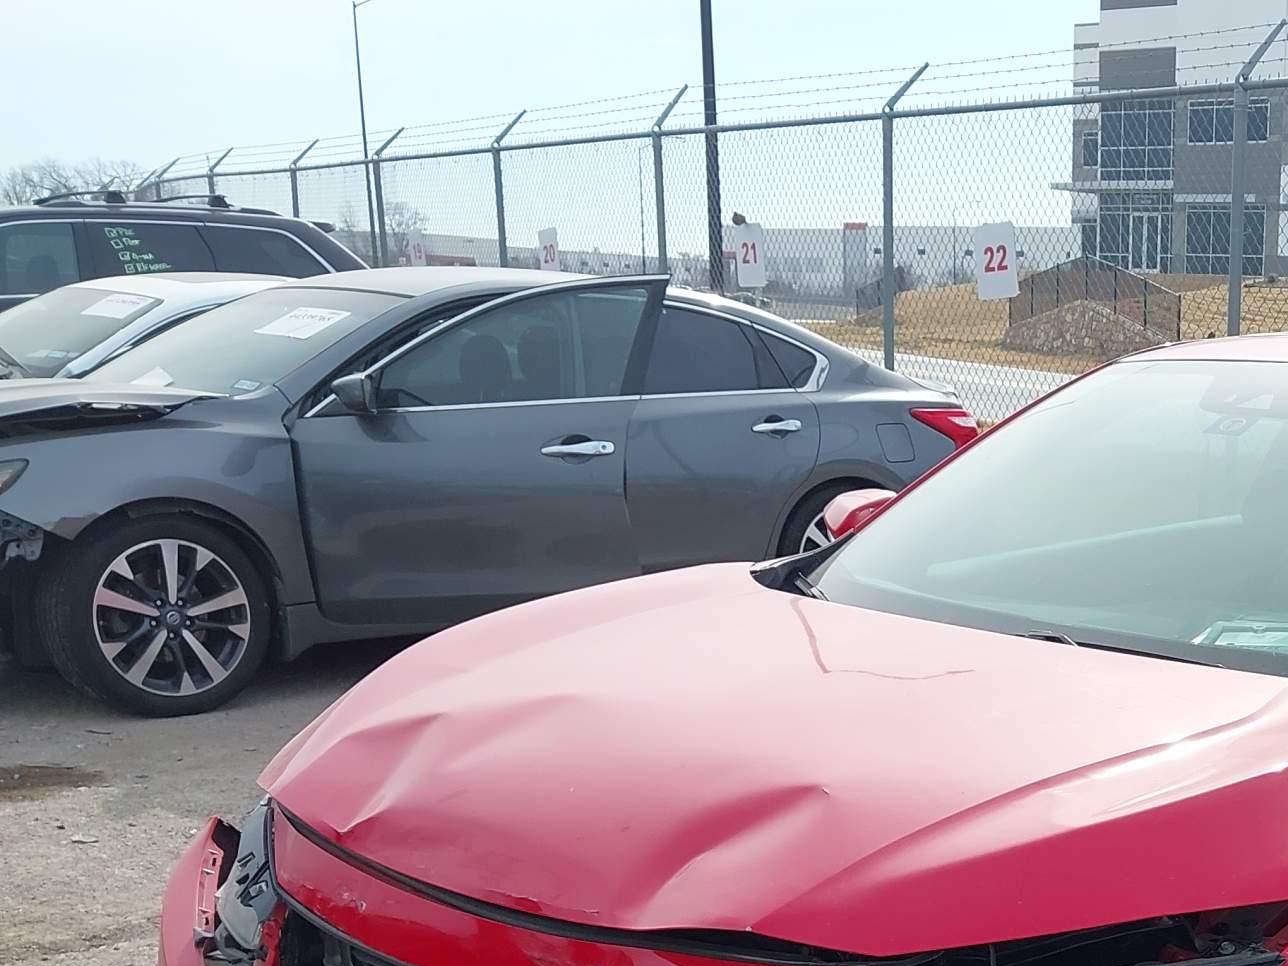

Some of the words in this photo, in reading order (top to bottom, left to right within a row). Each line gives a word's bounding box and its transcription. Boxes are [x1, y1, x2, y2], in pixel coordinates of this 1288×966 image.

[543, 243, 556, 264] 20
[741, 242, 757, 264] 21
[983, 244, 1008, 273] 22
